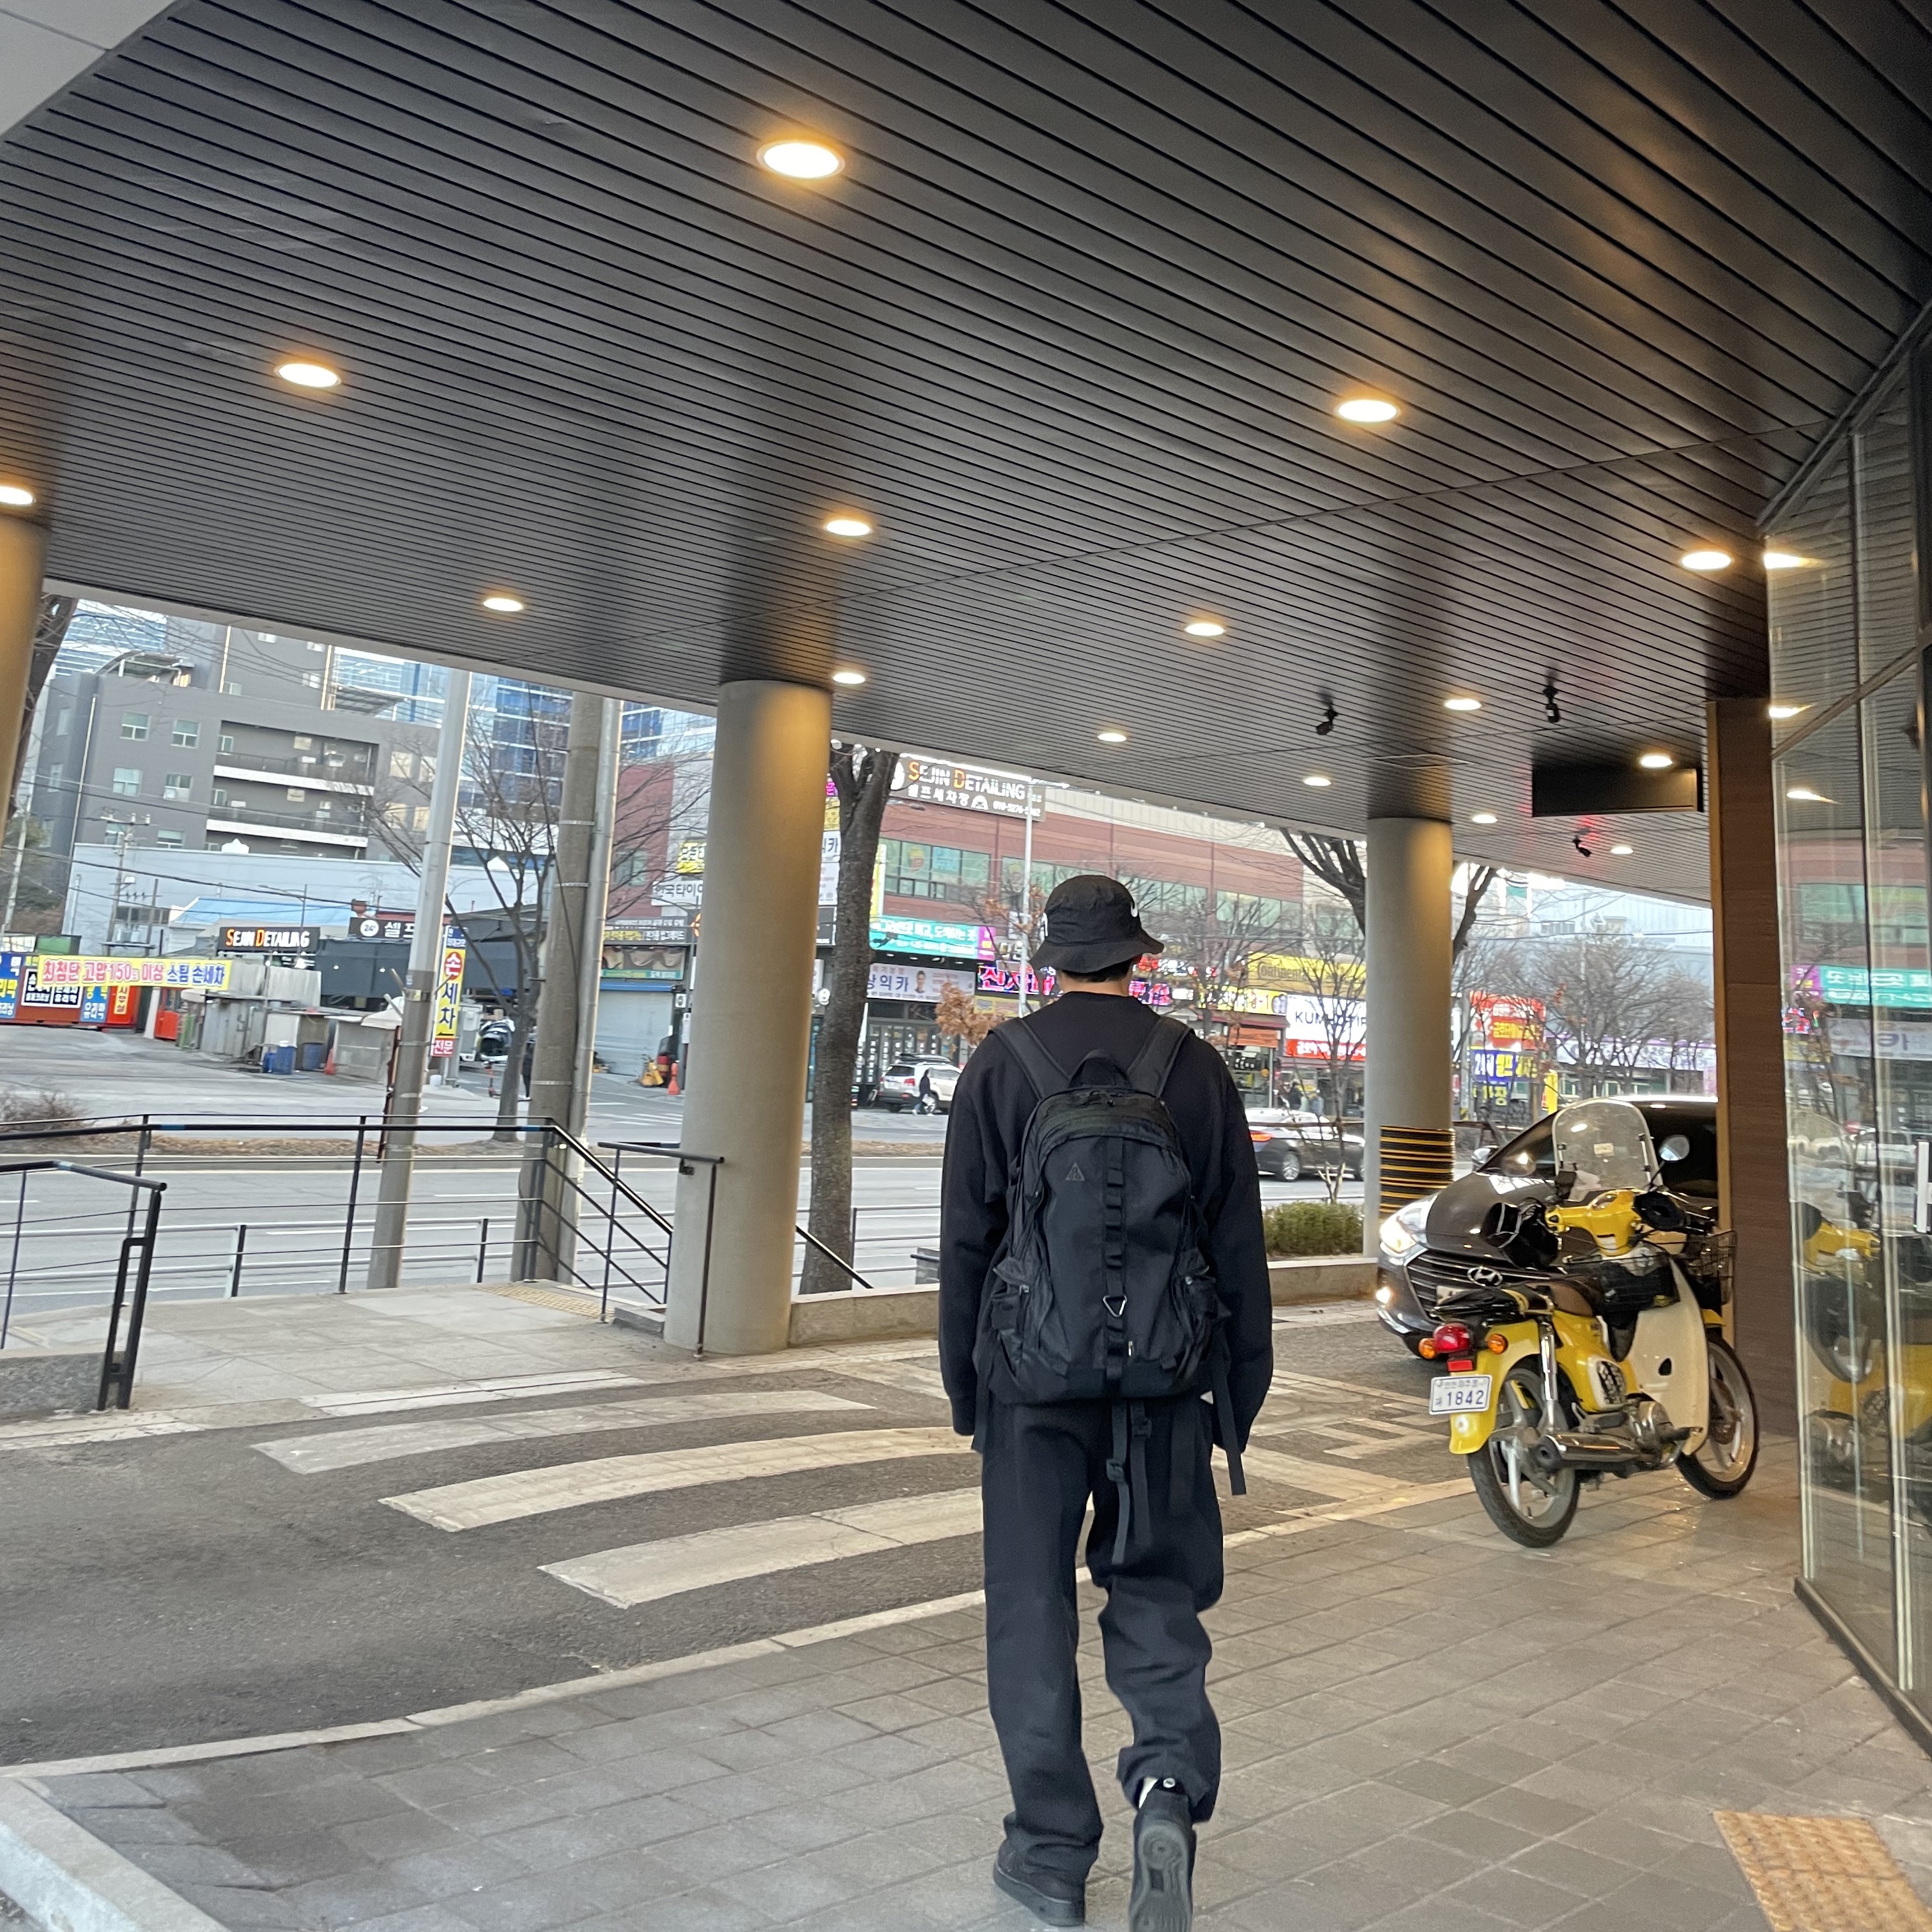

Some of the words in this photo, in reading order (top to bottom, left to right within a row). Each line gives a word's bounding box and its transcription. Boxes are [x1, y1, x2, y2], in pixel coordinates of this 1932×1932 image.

[42, 959, 80, 983] 최첨단
[165, 963, 190, 985] 스팀
[191, 965, 226, 986] 손세차
[1447, 1390, 1484, 1407] 1842
